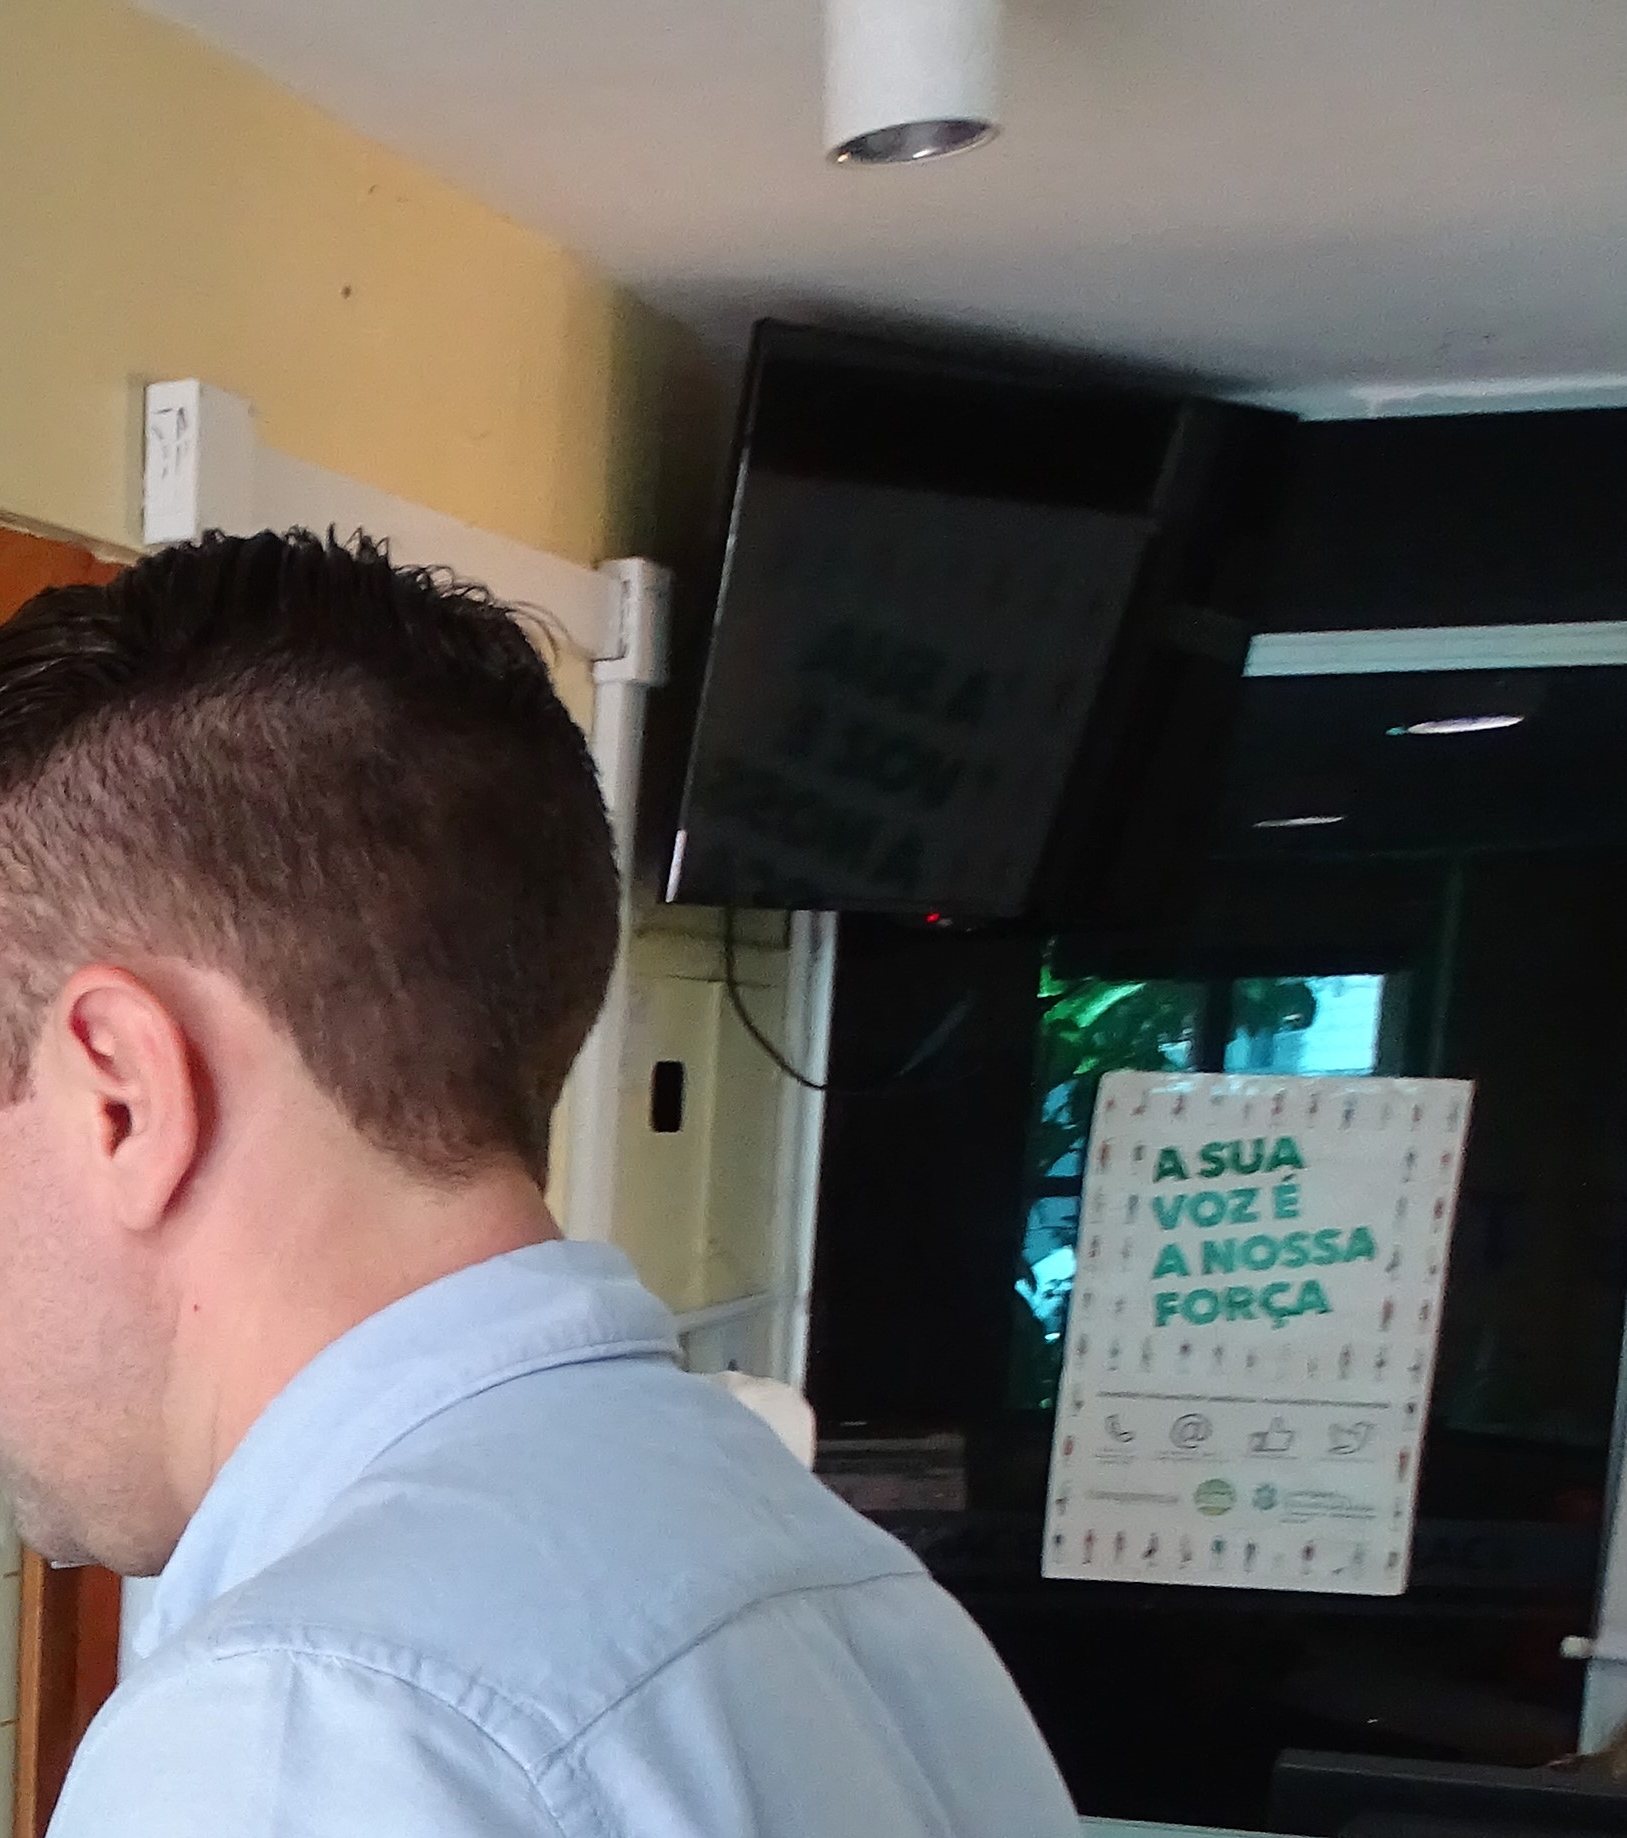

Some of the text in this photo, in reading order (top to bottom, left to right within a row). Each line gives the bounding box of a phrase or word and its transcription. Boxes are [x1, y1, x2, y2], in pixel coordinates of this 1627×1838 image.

[1152, 1134, 1305, 1184] A SUA
[1152, 1174, 1301, 1230] VOZ É
[1151, 1225, 1380, 1280] A NOSSA
[1154, 1279, 1333, 1329] FORÇA
